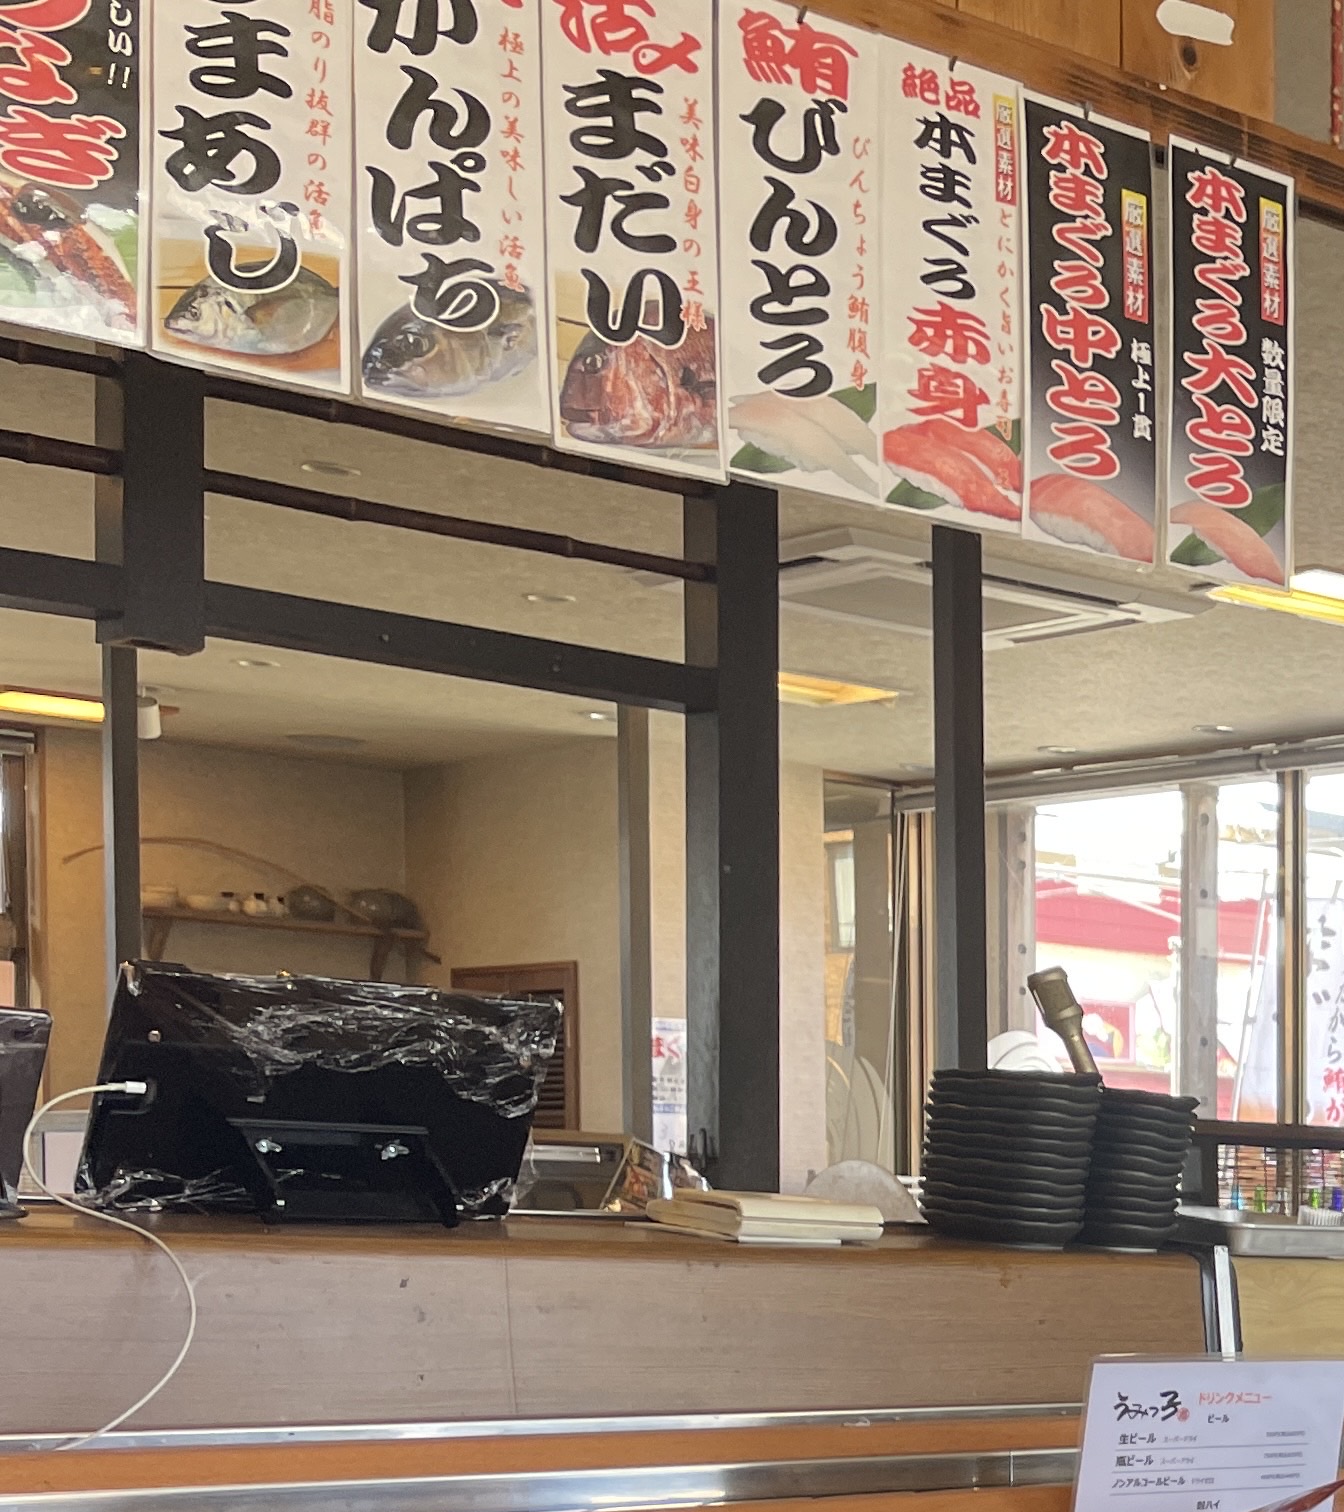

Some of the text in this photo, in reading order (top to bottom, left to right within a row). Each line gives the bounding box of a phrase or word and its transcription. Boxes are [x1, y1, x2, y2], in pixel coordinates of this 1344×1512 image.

[0, 0, 126, 189] なぎ
[157, 0, 300, 293] まあじ
[738, 8, 859, 101] 鮪
[901, 62, 981, 119] 絶品
[498, 27, 526, 293] 極上の美味しい活魚
[558, 69, 687, 347] まだい
[679, 97, 707, 331] 美味白身の王様
[739, 97, 848, 398] びんとろ
[846, 136, 871, 391] びんちょう鮪腹身
[1040, 120, 1123, 480] 本まぐろ中とろ
[1126, 200, 1149, 316] 厳選素材
[1181, 165, 1259, 508] 本まぐろ大とろ
[1262, 208, 1282, 319] 厳選素材
[1131, 338, 1153, 441] 極上一貫
[1260, 337, 1286, 457] 数量限定
[1119, 1432, 1157, 1445] 生ビール
[1198, 1390, 1273, 1405] ドリンクメニュー
